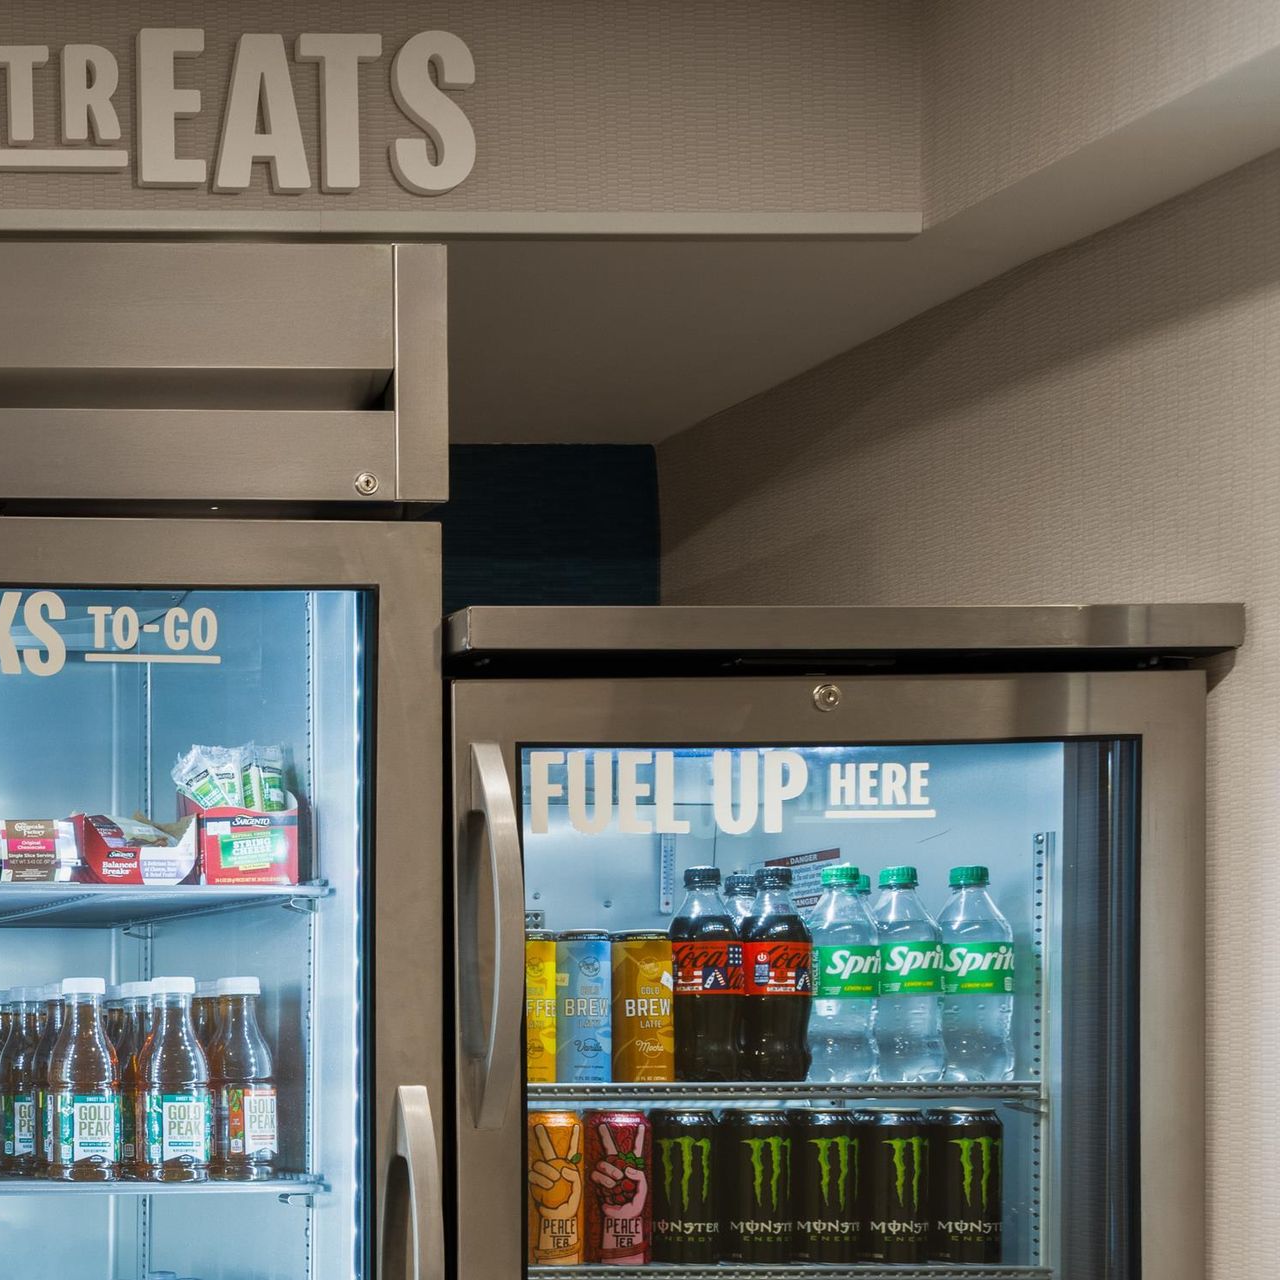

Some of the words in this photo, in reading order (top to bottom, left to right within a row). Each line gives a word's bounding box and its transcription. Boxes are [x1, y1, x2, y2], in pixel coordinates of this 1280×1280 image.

[86, 605, 219, 653] TO-GO
[529, 751, 690, 834] FUEL
[712, 750, 809, 834] UP
[830, 763, 930, 805] HERE
[232, 816, 271, 826] SARGENTO
[232, 838, 272, 848] STRING
[790, 854, 818, 865] DANGER
[640, 986, 661, 996] COLD
[625, 999, 670, 1017] BREW
[640, 1020, 662, 1029] LATTE
[78, 1105, 111, 1120] GOLD
[168, 1104, 200, 1120] GOLD
[249, 1099, 276, 1114] GOLD
[79, 1121, 111, 1136] PEAK
[168, 1121, 201, 1136] PEAK
[249, 1114, 276, 1129] PEAK
[543, 1219, 577, 1234] PEACE
[606, 1218, 640, 1234] PEACE
